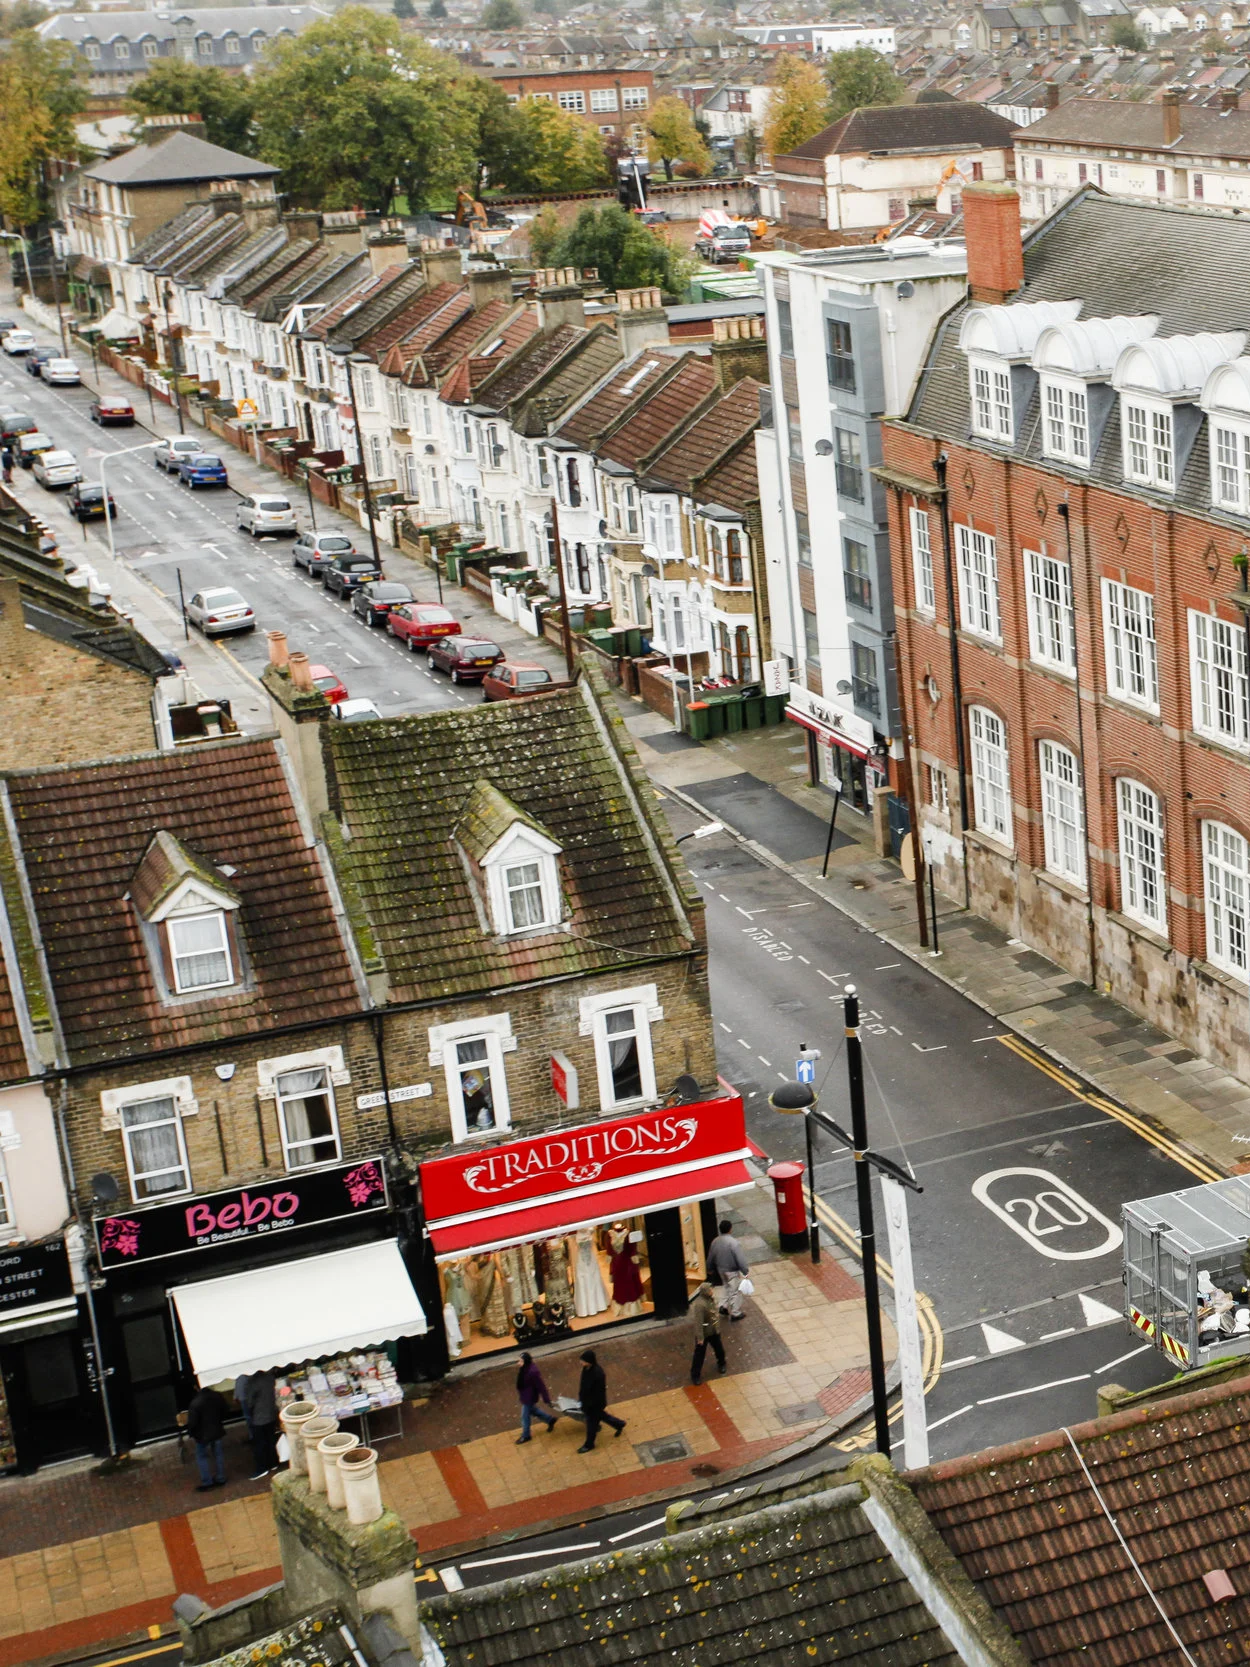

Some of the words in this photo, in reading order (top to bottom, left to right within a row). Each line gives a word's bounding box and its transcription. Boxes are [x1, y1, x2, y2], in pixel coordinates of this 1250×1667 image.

[741, 927, 794, 961] DISABLED
[829, 994, 887, 1034] DIBLED
[390, 1087, 420, 1100] STREET
[480, 1116, 678, 1181] TRADITIONS
[185, 1191, 300, 1238] Bebo
[1005, 1192, 1088, 1236] 20
[45, 1242, 61, 1252] 162
[196, 1236, 210, 1245] Be
[257, 1223, 270, 1232] Be
[271, 1218, 295, 1229] Bebo
[4, 1269, 44, 1284] STREET
